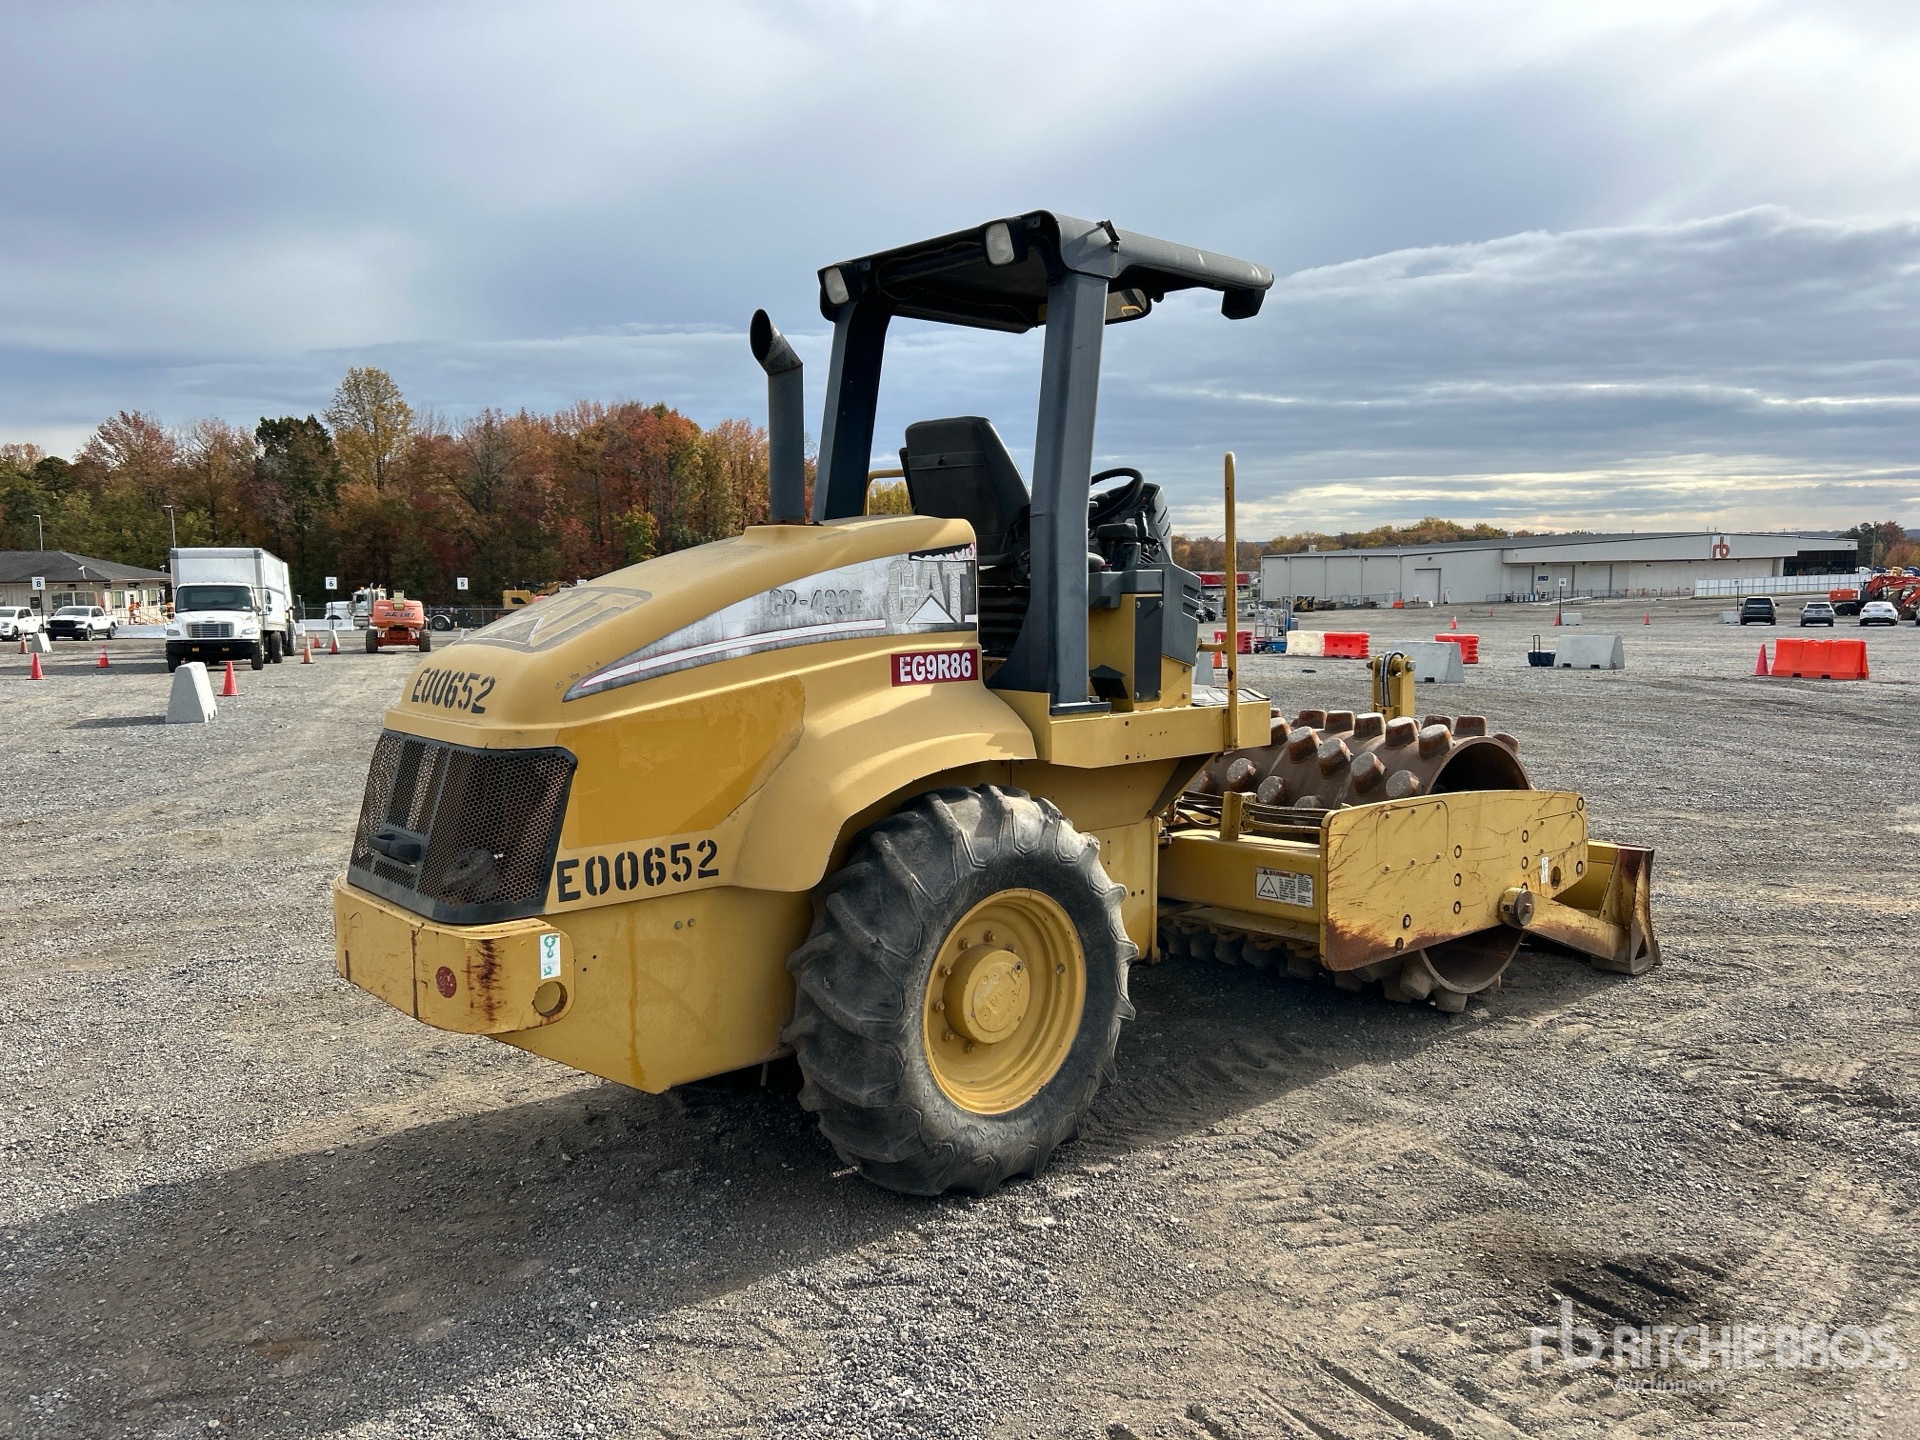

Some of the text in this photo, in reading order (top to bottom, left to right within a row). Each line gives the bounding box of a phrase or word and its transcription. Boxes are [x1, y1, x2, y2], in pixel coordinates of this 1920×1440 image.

[1712, 536, 1730, 559] rb
[889, 559, 967, 625] CAT
[411, 667, 496, 714] E00652
[899, 652, 972, 683] EG9R86
[556, 839, 719, 903] E00652
